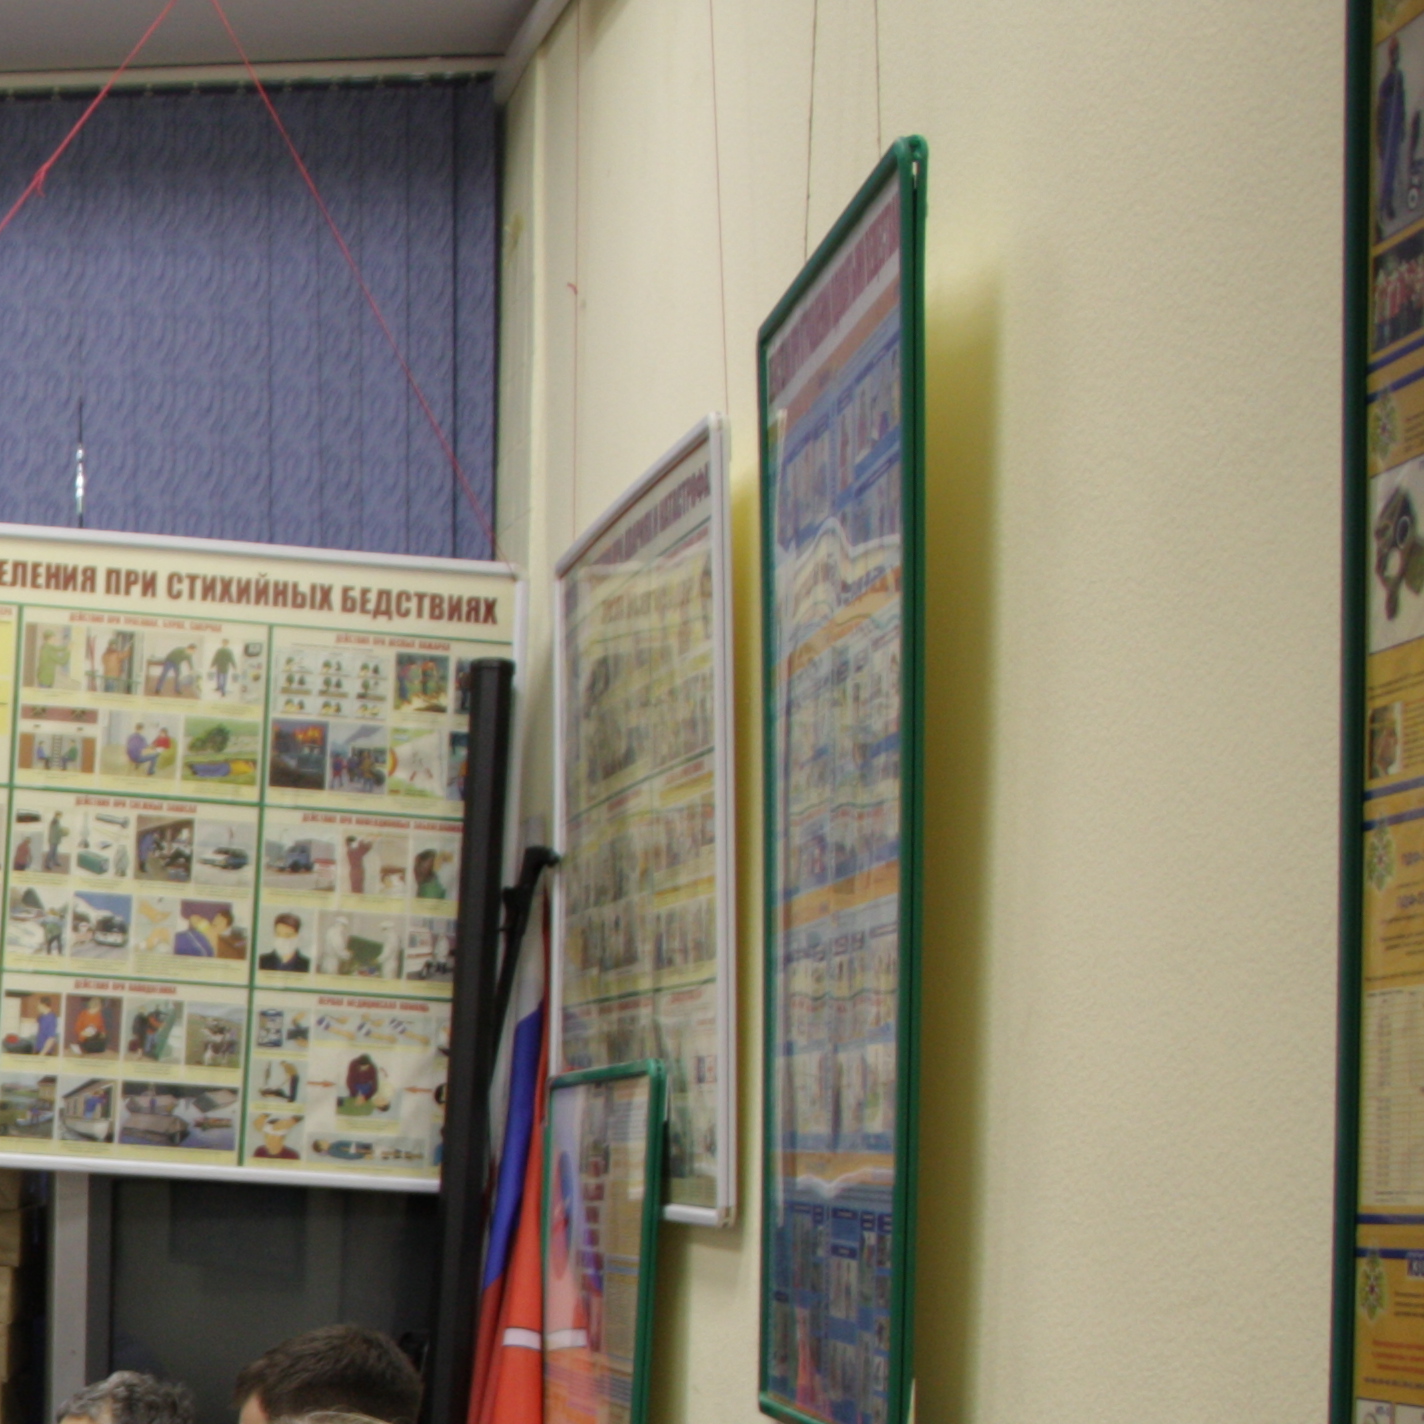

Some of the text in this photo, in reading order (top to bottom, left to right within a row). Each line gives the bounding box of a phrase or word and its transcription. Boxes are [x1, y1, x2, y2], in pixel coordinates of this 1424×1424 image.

[105, 567, 158, 599] ПРИ
[166, 571, 334, 612] СТИХИЙНЫХ
[340, 585, 499, 625] БЕДСТВИЯХ
